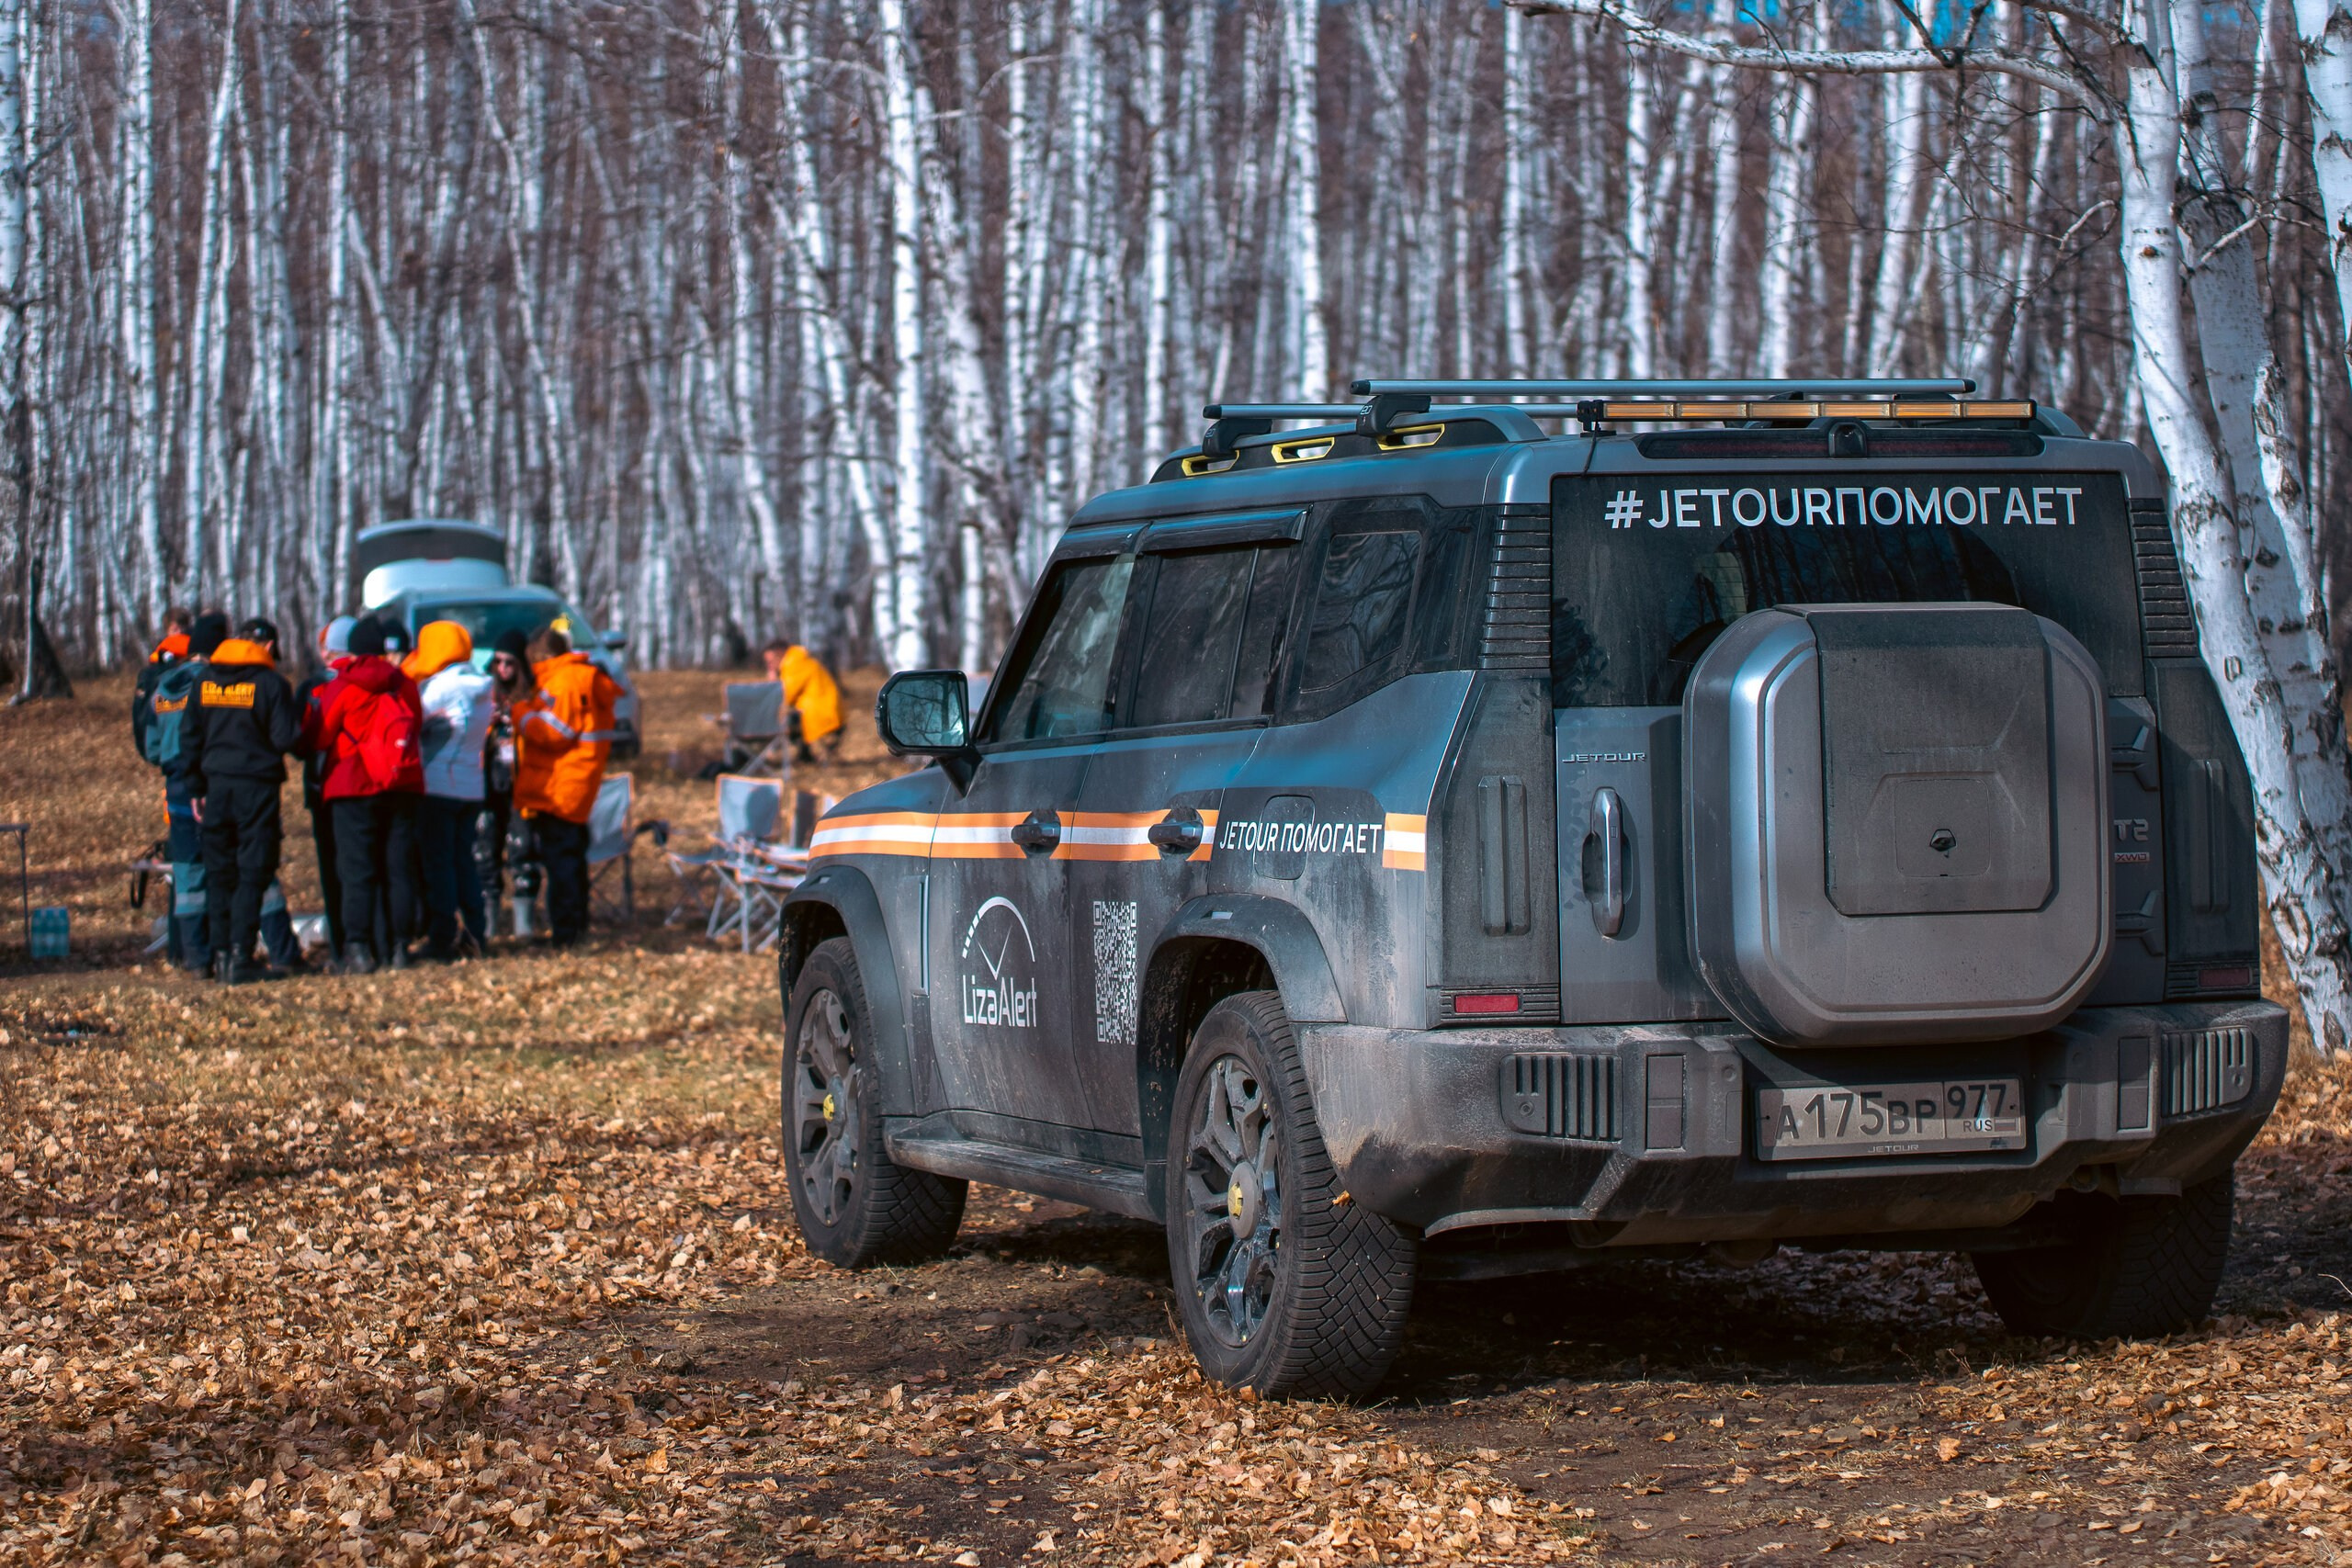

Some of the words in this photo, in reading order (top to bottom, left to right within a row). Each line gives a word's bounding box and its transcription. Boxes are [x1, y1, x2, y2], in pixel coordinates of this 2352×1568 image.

[1562, 752, 1646, 763] JETOUR
[1220, 821, 1279, 852] JETOUR
[1280, 823, 1383, 853] ПОМОГАЕТ
[2113, 818, 2149, 841] T2
[2116, 852, 2148, 863] XWD
[962, 975, 1037, 1028] LizaAlert
[1947, 1084, 2007, 1119] 977
[1962, 1118, 1994, 1133] RUS
[1868, 1144, 1919, 1153] JETOUR
